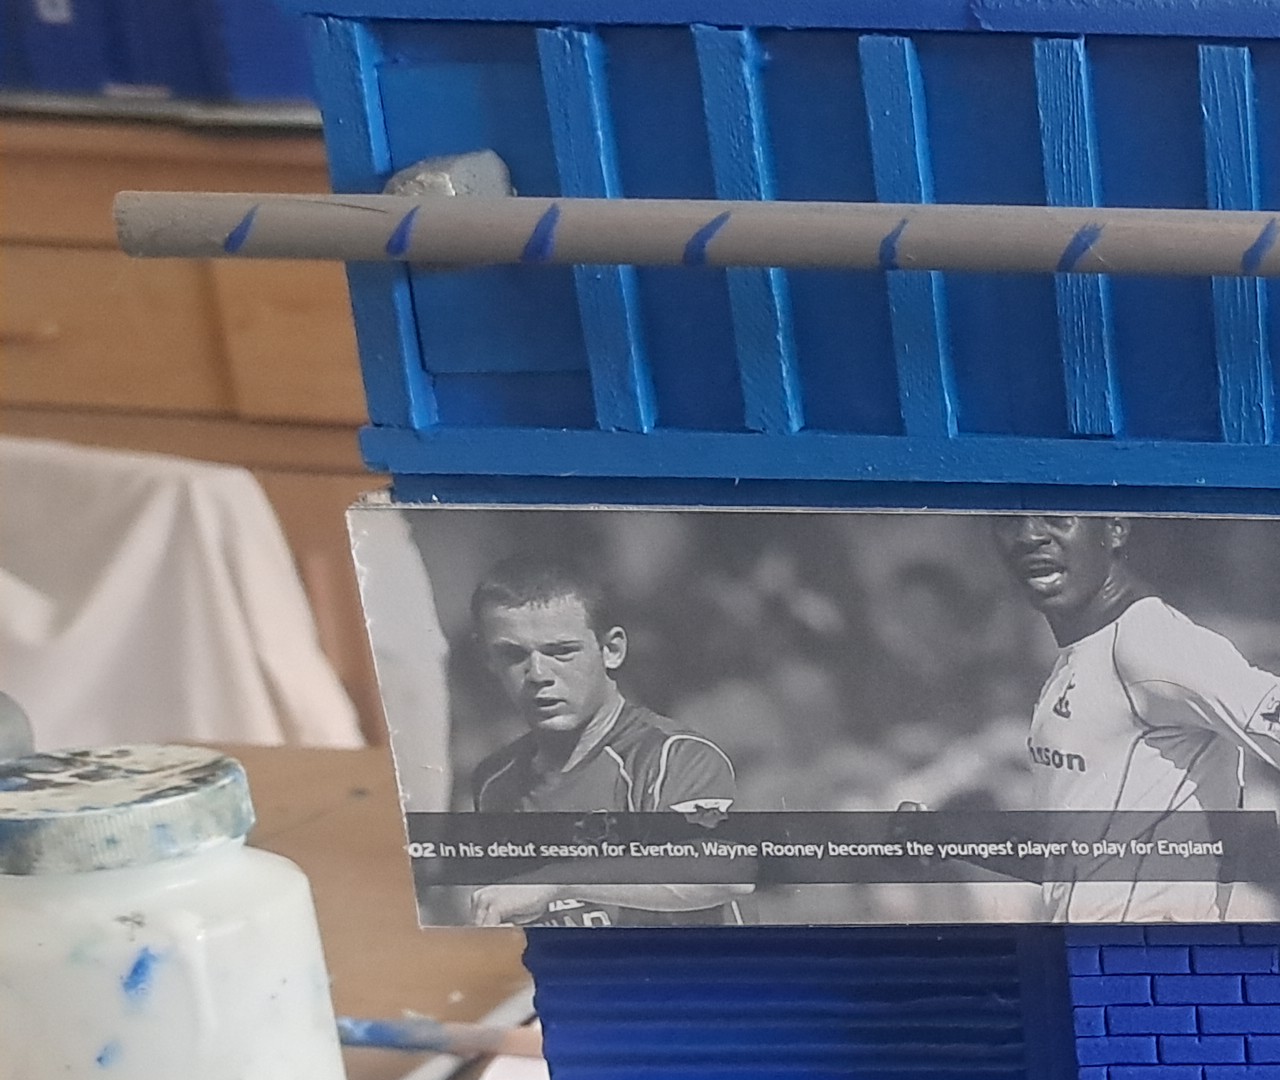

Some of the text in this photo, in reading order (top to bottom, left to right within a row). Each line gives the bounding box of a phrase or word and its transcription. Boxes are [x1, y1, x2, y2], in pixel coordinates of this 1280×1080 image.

[440, 843, 455, 856] In
[459, 843, 483, 856] his
[488, 842, 536, 857] debut
[540, 845, 598, 856] season
[602, 842, 625, 856] for
[630, 843, 698, 858] Everton,
[702, 842, 757, 859] Wayne
[762, 842, 823, 859] Rooney
[828, 842, 902, 855] becomes
[907, 842, 934, 855] the
[938, 841, 1013, 858] youngest
[1018, 841, 1068, 858] player
[1072, 841, 1089, 854] to
[1093, 840, 1126, 857] play
[1131, 840, 1154, 854] for
[1158, 840, 1223, 857] England
